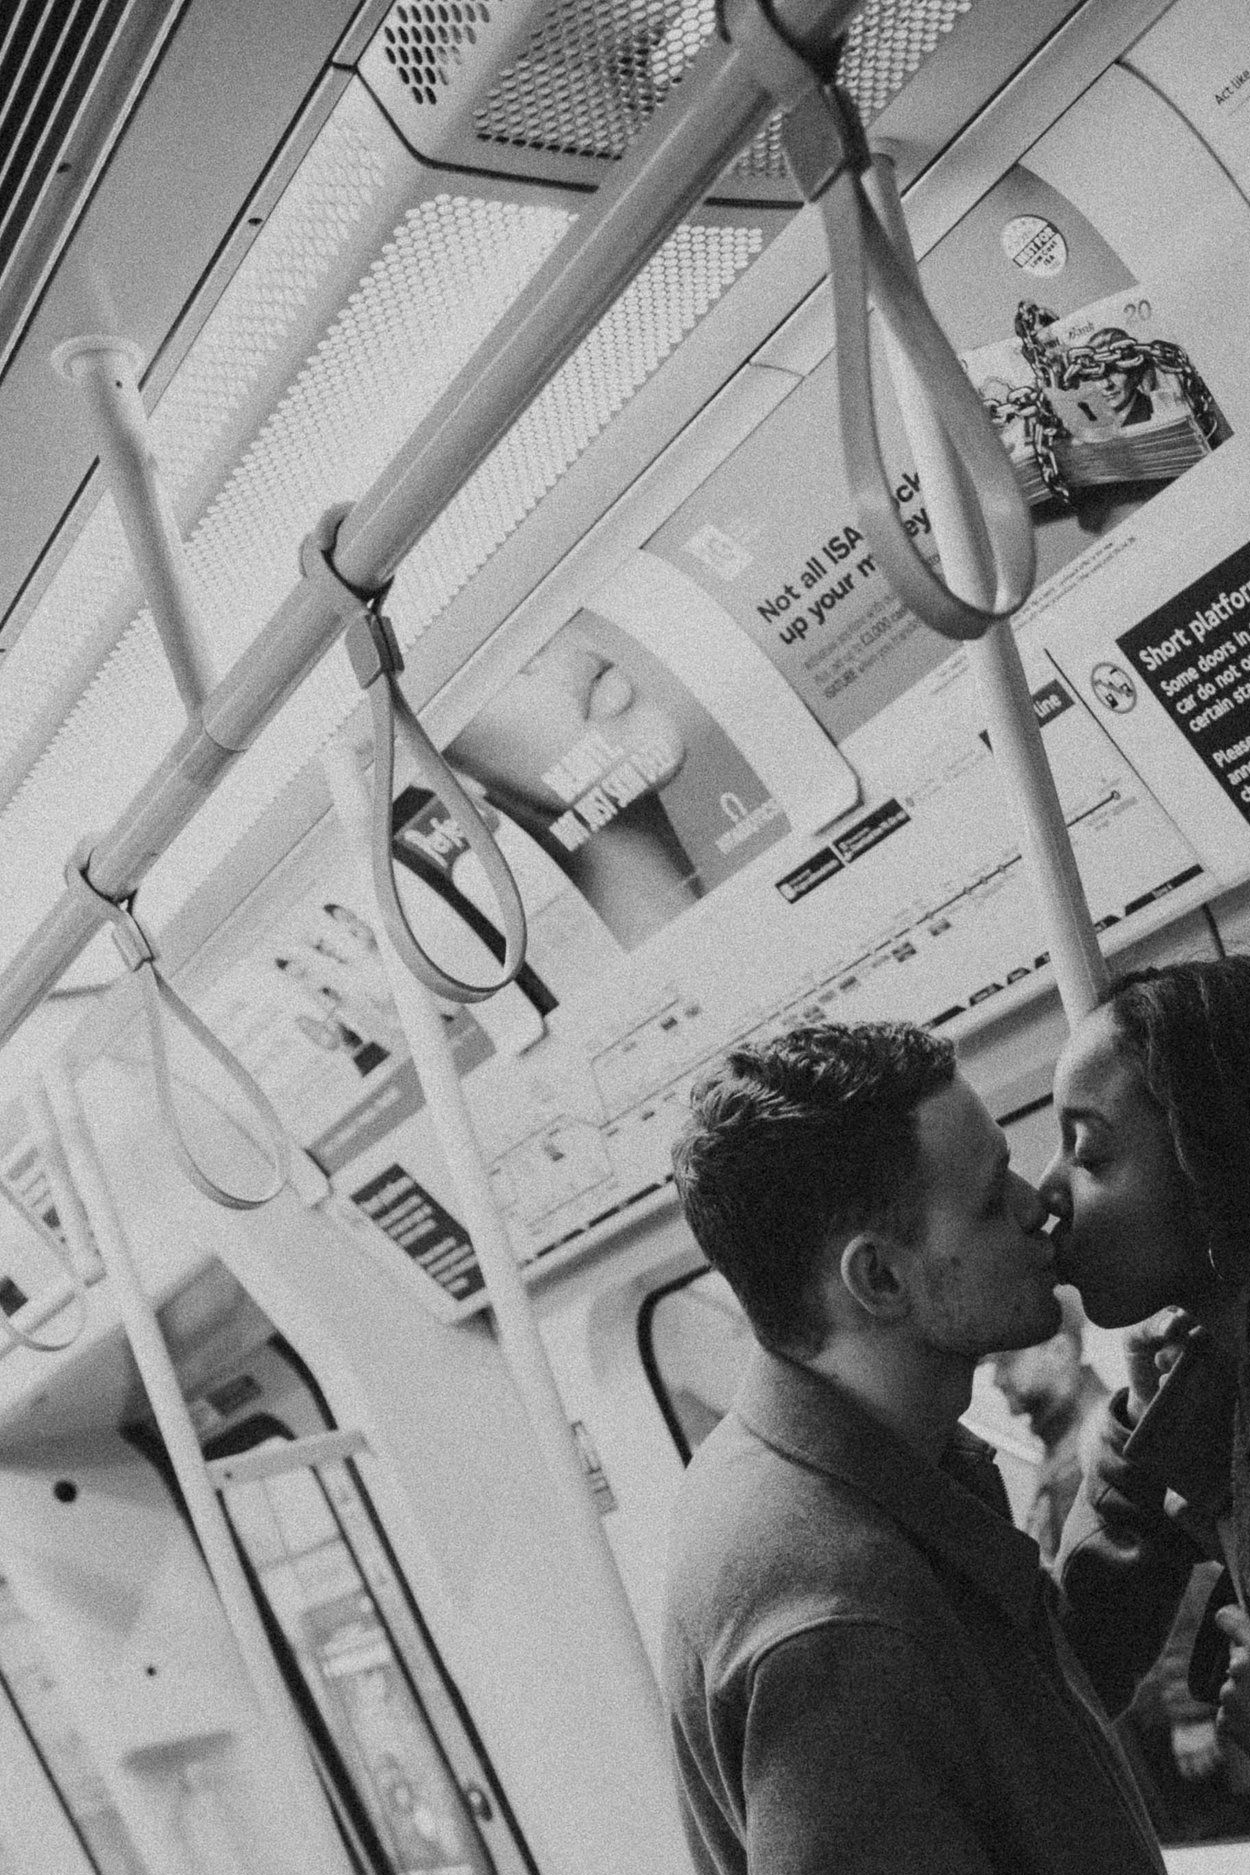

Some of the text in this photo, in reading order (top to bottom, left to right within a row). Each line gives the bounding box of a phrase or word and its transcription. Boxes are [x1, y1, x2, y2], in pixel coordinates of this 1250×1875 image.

[1214, 86, 1234, 105] Act
[1122, 298, 1153, 323] 20
[756, 584, 802, 624] Not
[800, 556, 828, 590] all
[779, 616, 809, 645] up
[807, 573, 855, 626] your
[1138, 628, 1192, 671] Short
[1160, 666, 1200, 697] Some
[1197, 640, 1237, 673] doors
[1175, 693, 1197, 715] car
[1196, 682, 1217, 701] do
[1214, 664, 1242, 688] not
[1189, 697, 1235, 733] certain
